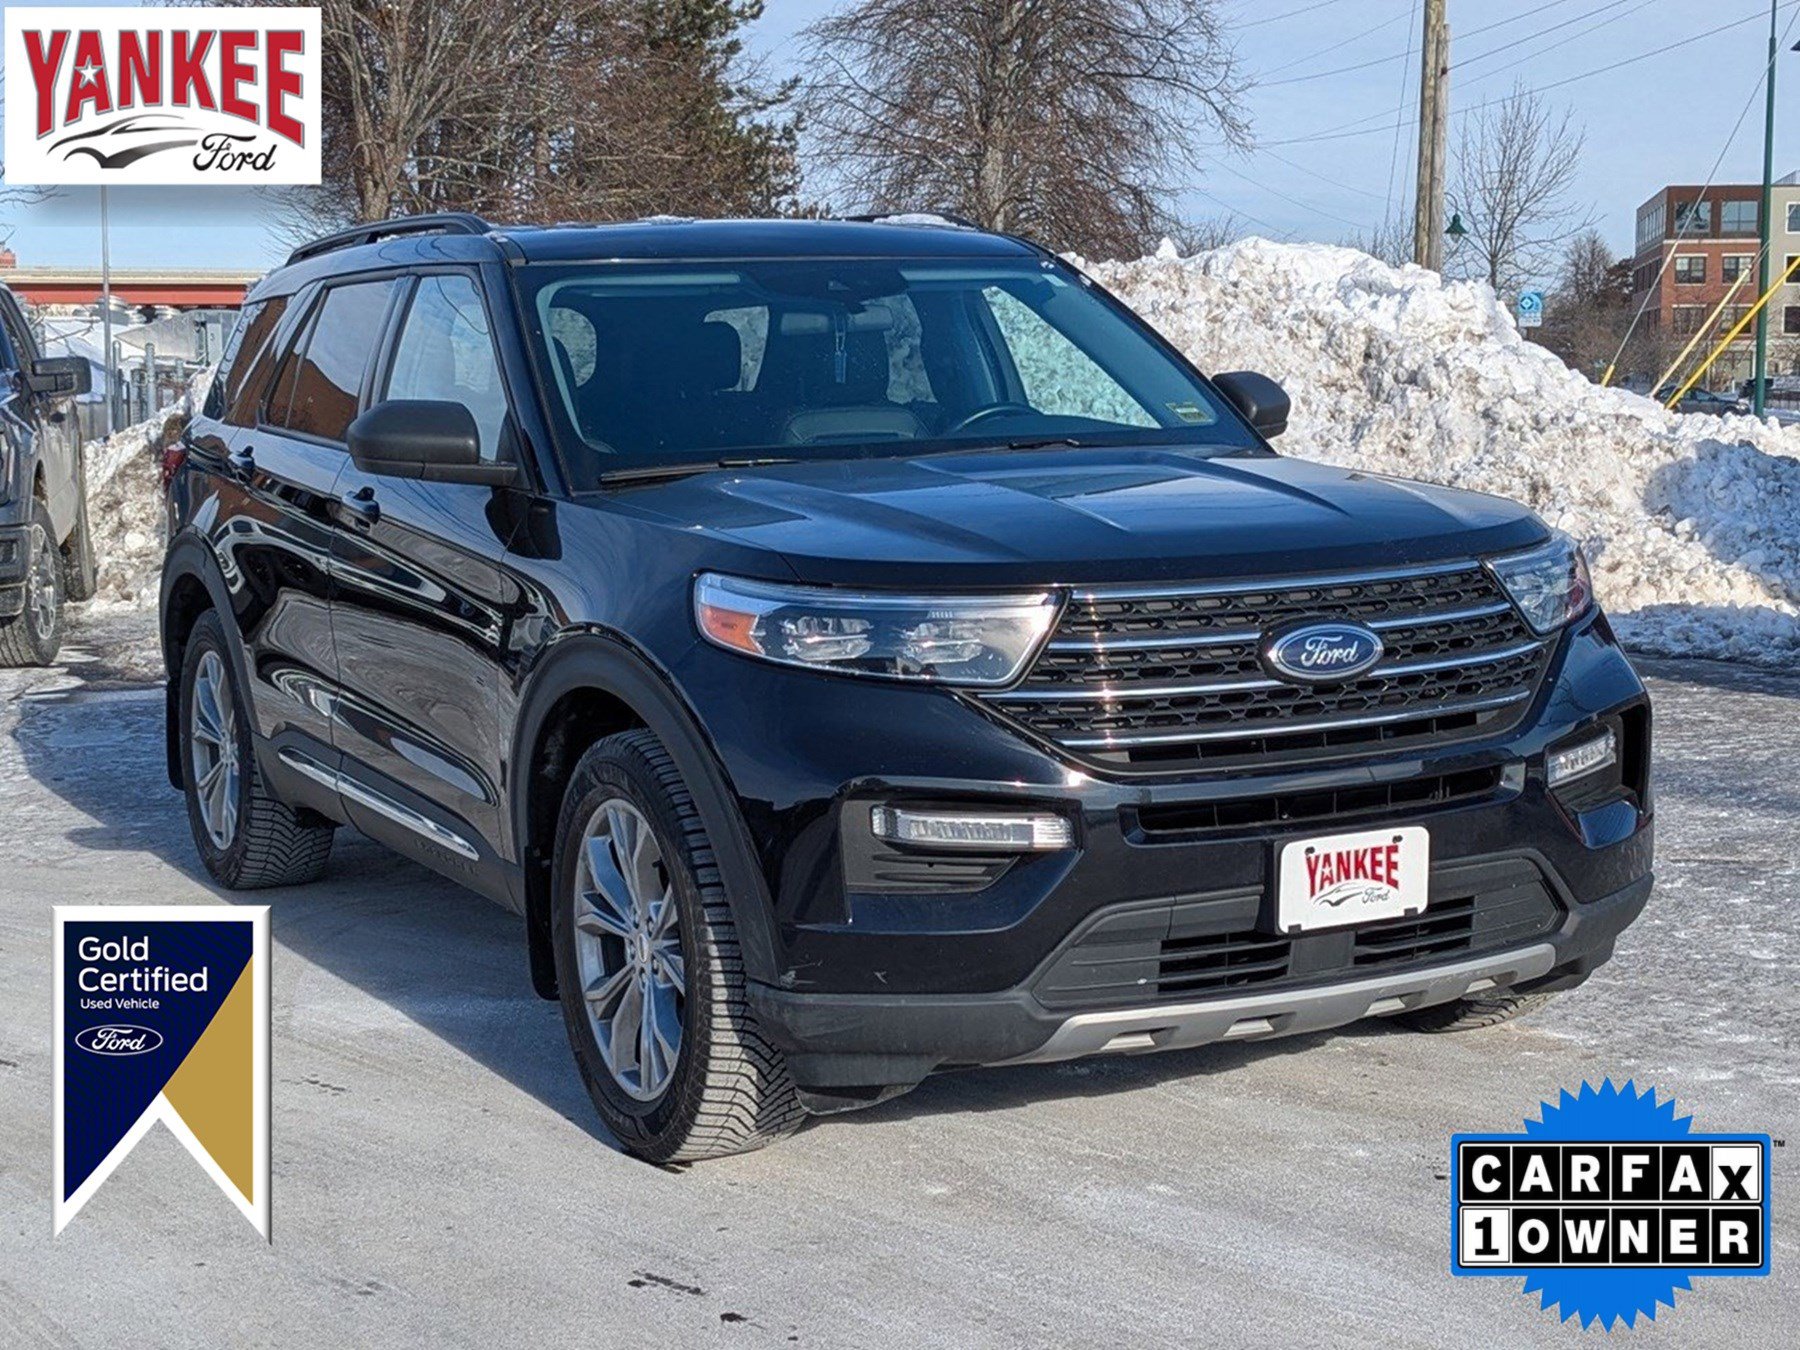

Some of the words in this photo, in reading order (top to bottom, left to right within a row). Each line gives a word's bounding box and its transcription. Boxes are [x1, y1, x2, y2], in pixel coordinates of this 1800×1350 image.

[1301, 635, 1359, 667] Ford
[1305, 844, 1400, 898] YANKEE
[1362, 886, 1391, 904] Ford
